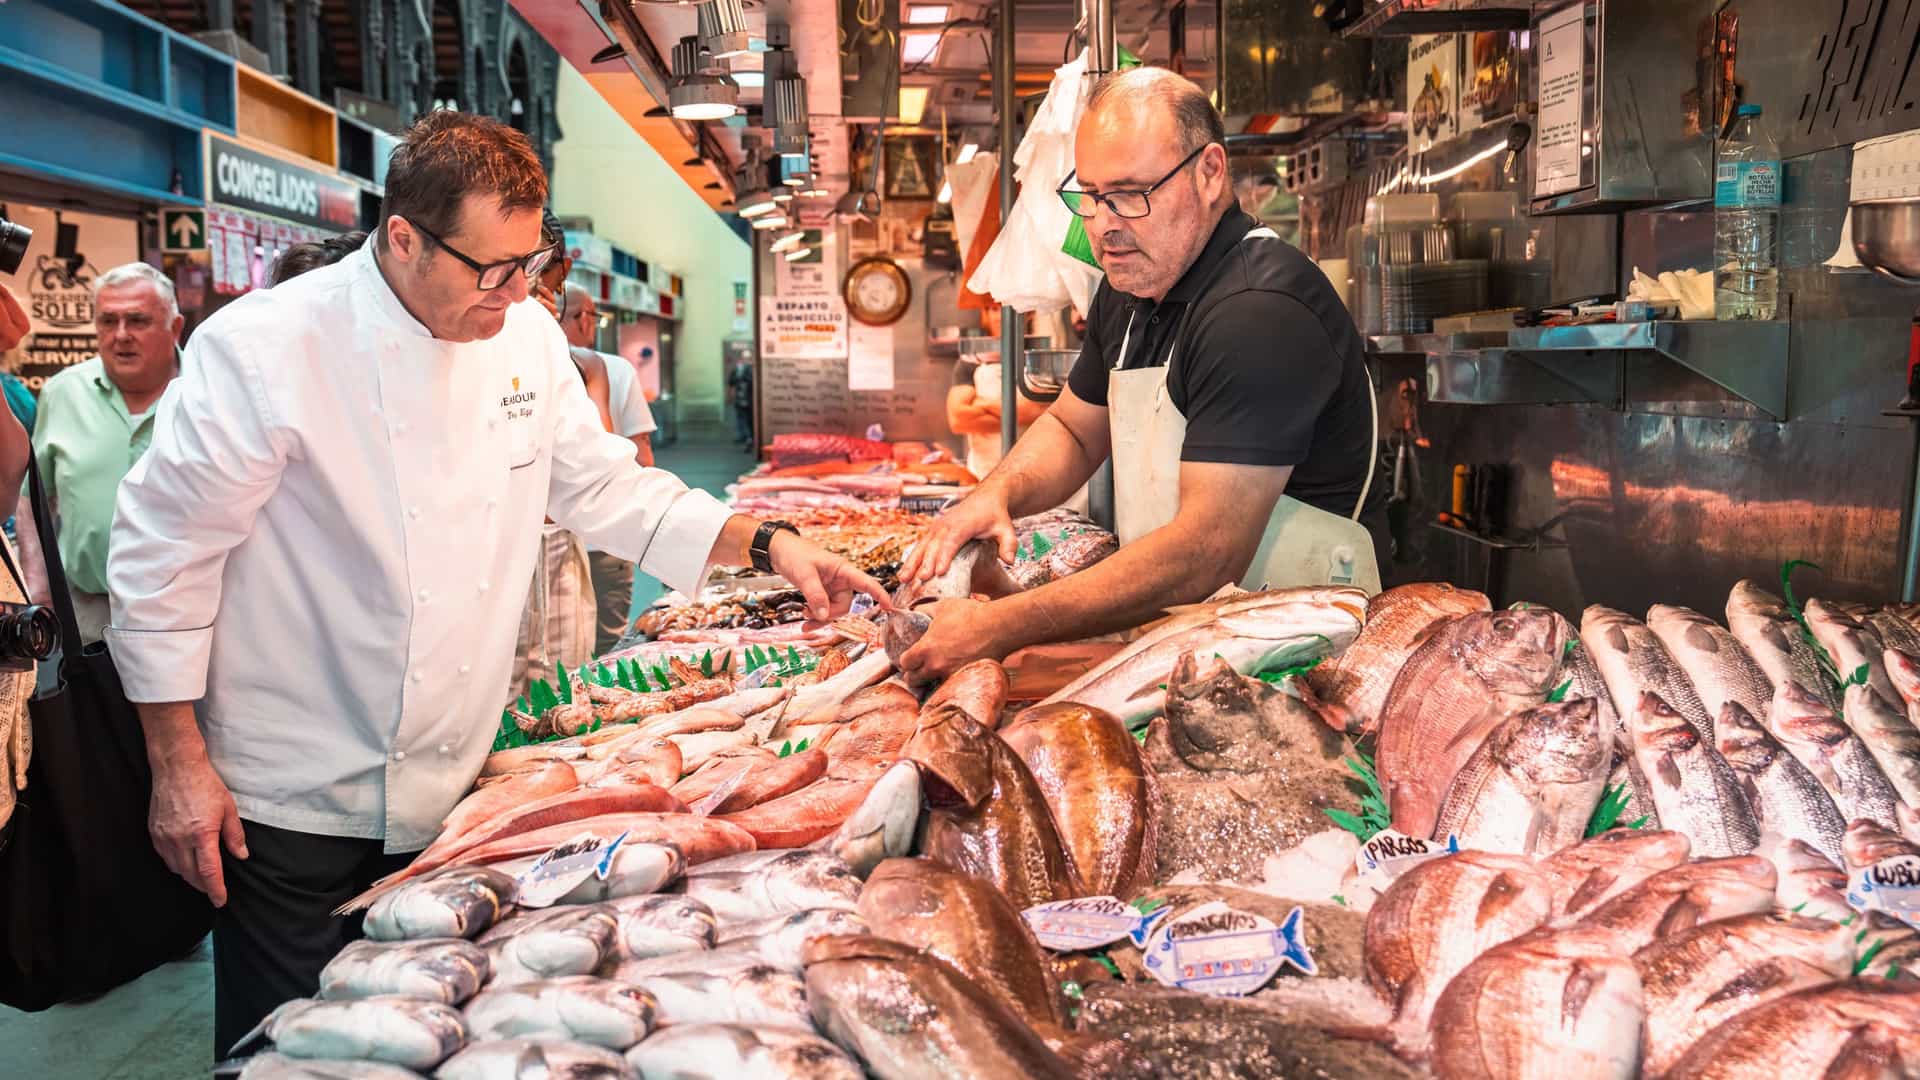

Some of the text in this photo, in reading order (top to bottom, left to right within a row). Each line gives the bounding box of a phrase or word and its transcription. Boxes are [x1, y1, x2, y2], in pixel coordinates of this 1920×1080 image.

[217, 151, 319, 217] CONGELADOS
[776, 302, 829, 310] REPARTO
[778, 313, 842, 322] DOMICILIO
[1367, 835, 1429, 862] PARGOS
